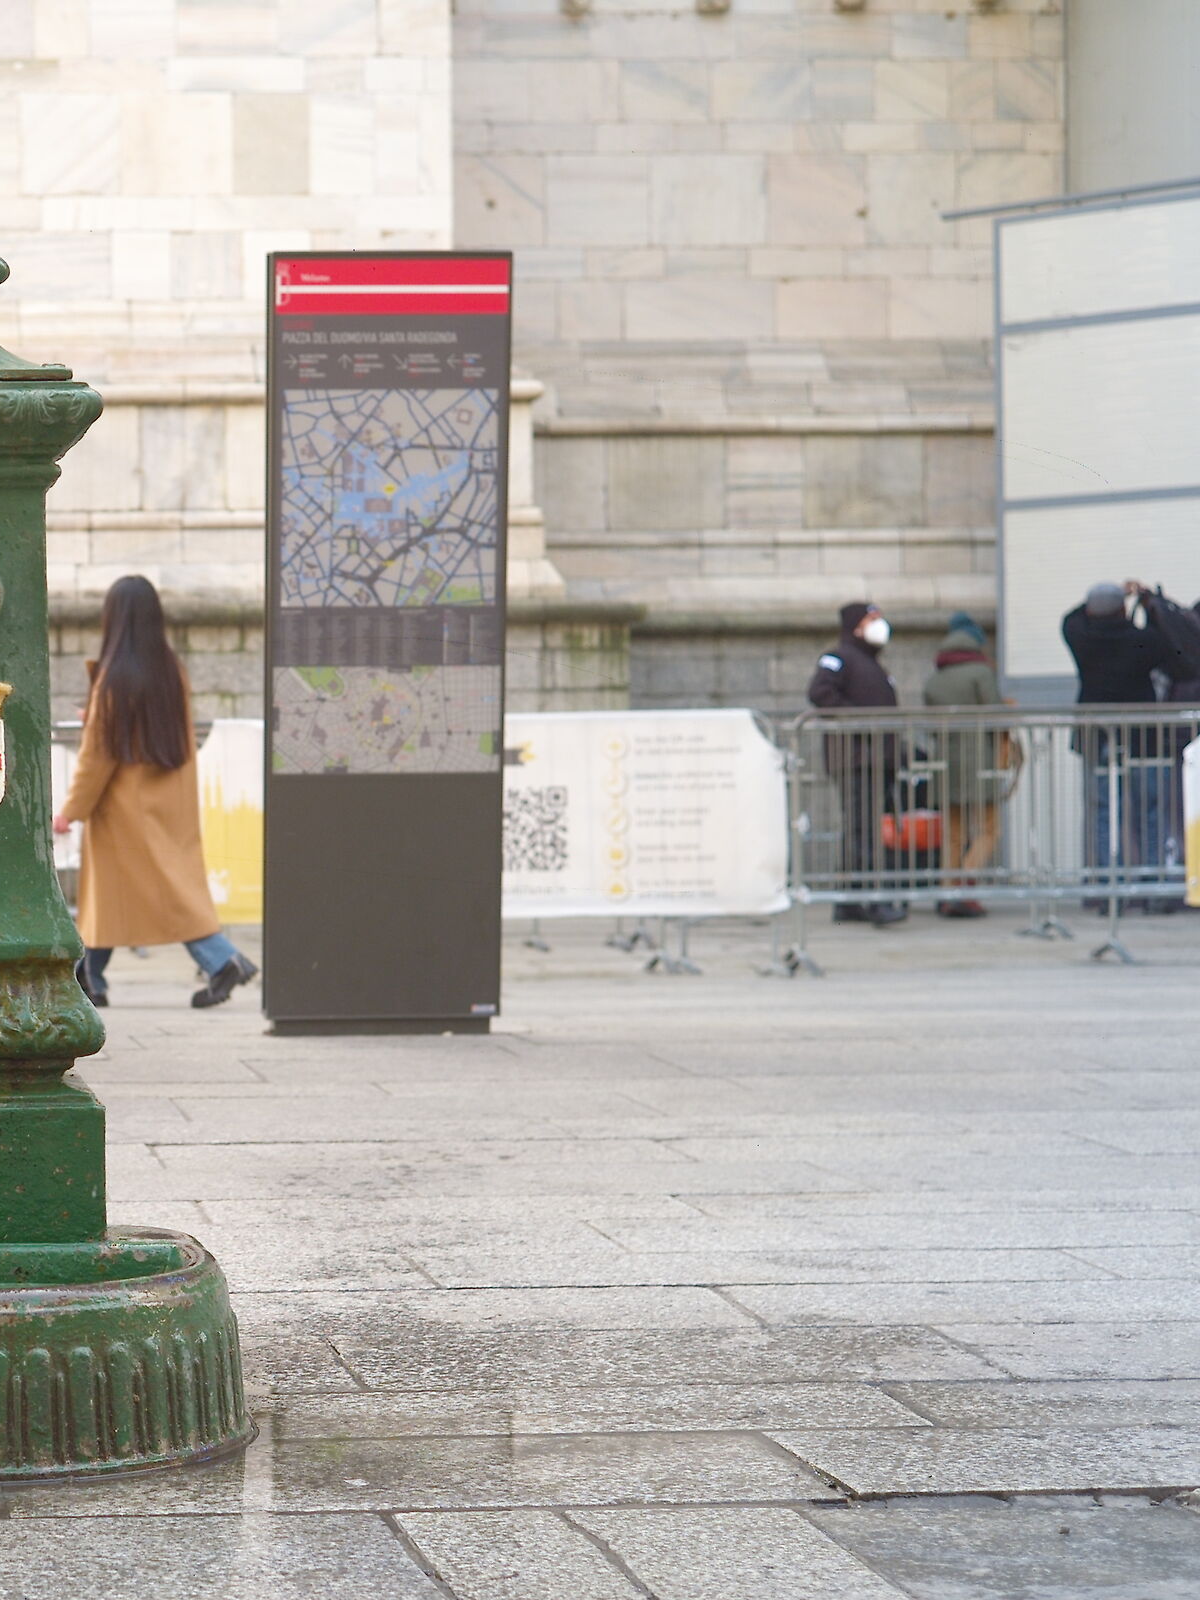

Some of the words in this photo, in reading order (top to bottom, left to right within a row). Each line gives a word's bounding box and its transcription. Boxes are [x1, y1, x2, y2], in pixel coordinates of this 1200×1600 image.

[281, 331, 311, 344] PIAZZA
[313, 331, 328, 344] DEL
[379, 331, 406, 344] SANTA
